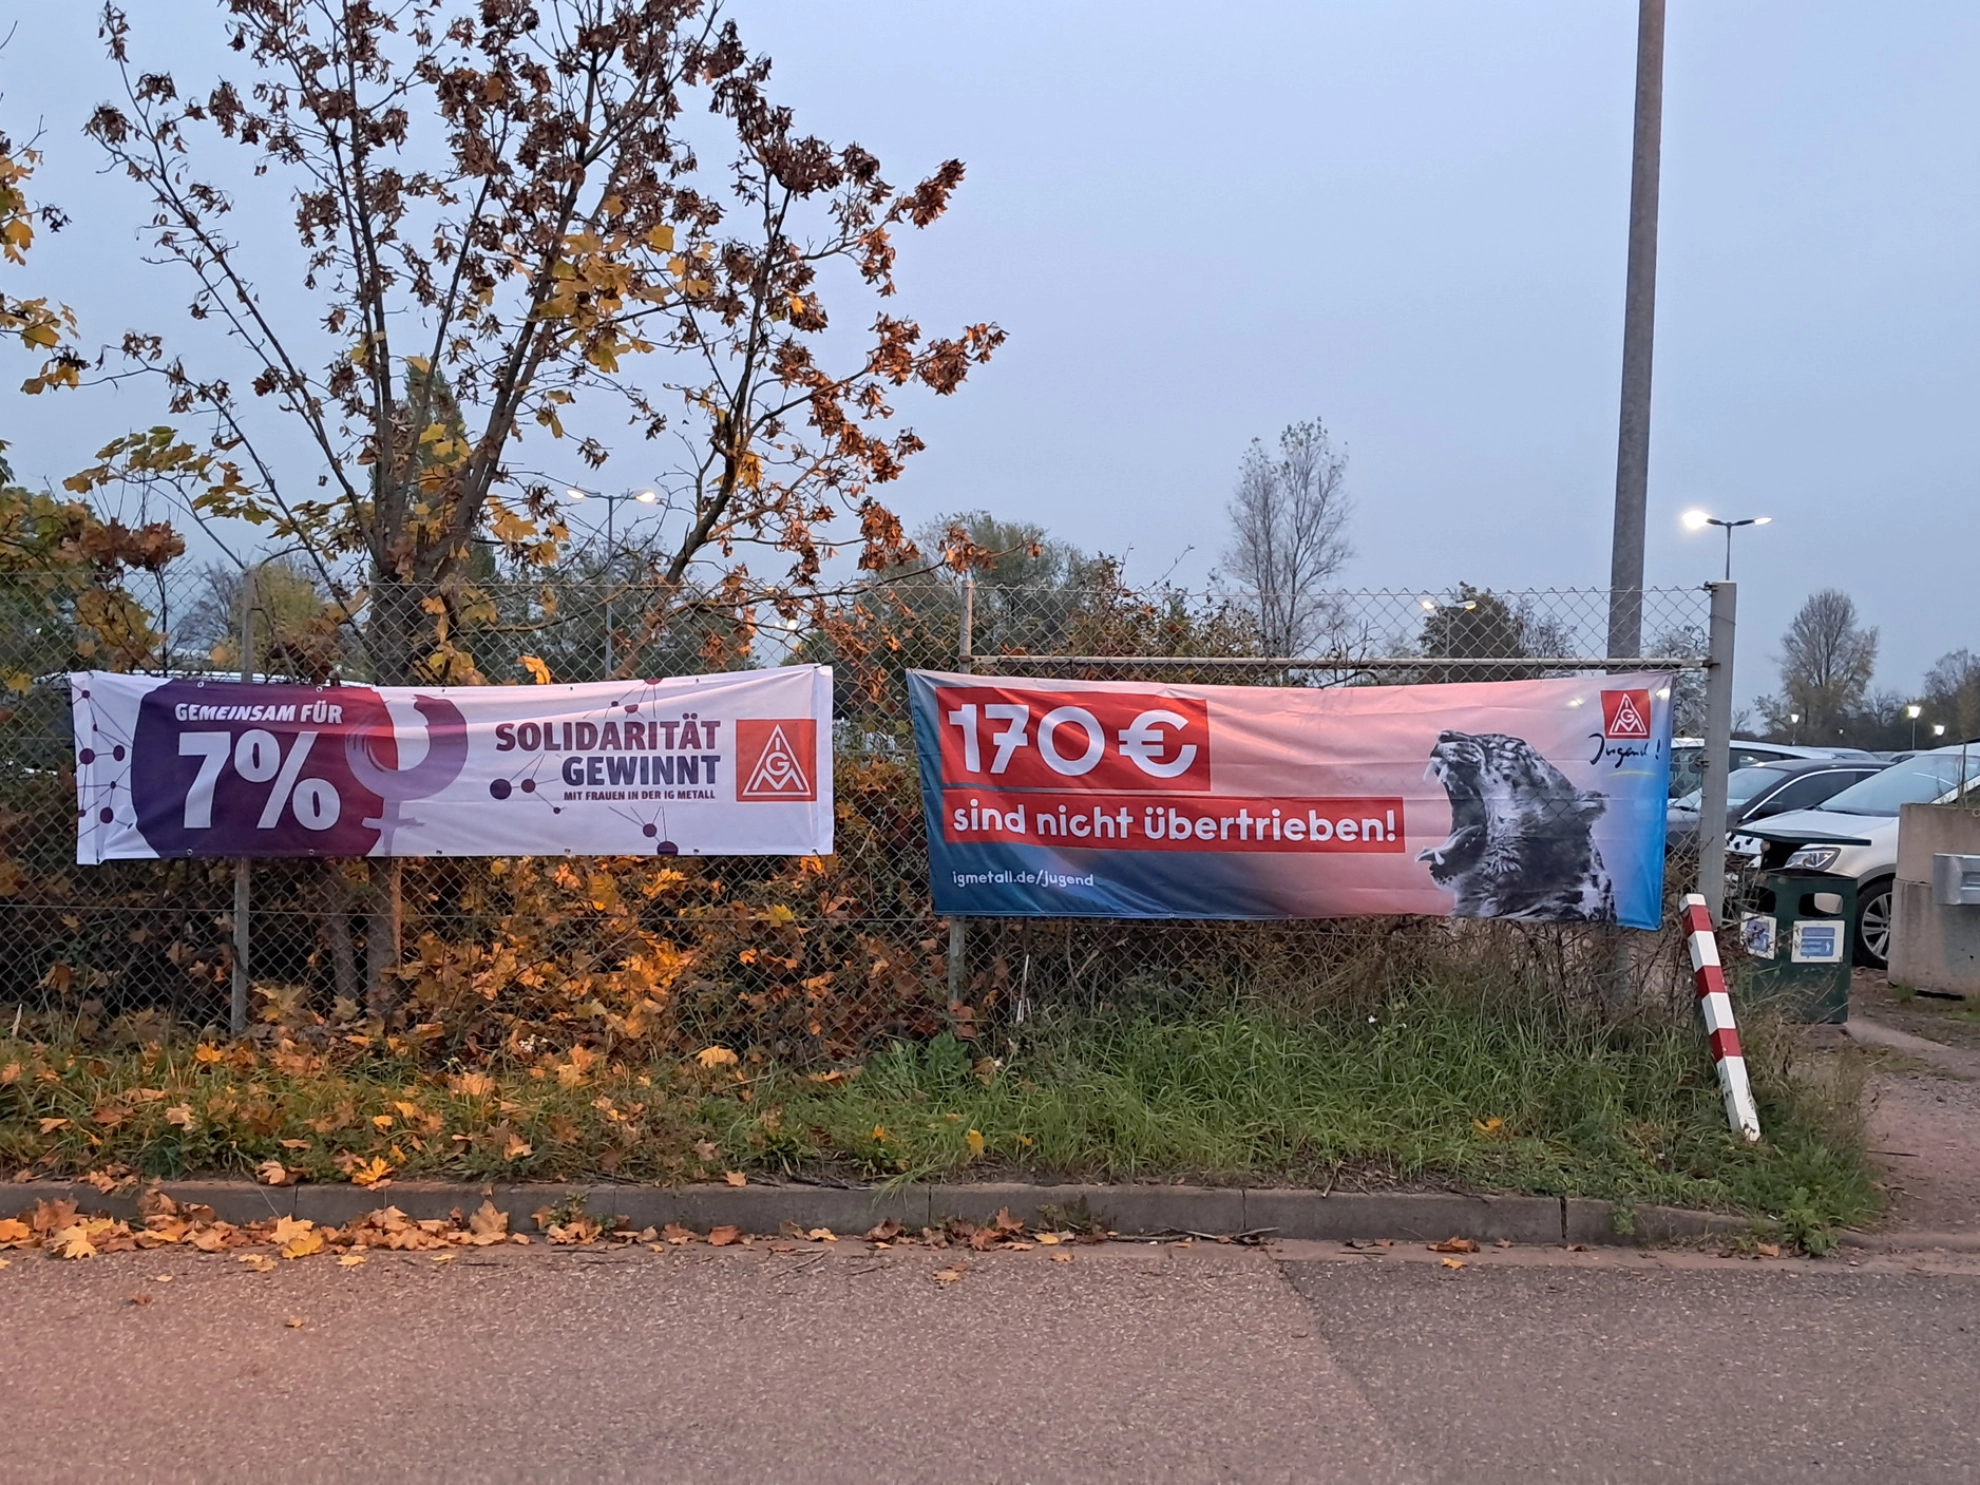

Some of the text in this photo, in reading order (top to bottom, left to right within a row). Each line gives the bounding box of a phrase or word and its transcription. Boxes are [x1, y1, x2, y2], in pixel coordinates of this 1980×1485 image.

[174, 700, 343, 724] GEMEINSAM FÜR
[495, 713, 721, 752] SOLIDARITÄT
[948, 703, 1197, 778] 170 €
[178, 728, 341, 831] 7%
[561, 755, 721, 786] GEWINNT
[564, 789, 716, 801] MIT FRAUEN IN DER IG METALL
[953, 798, 1397, 842] sind nicht übertrieben!
[952, 869, 1095, 888] igmetall.de/jugend
